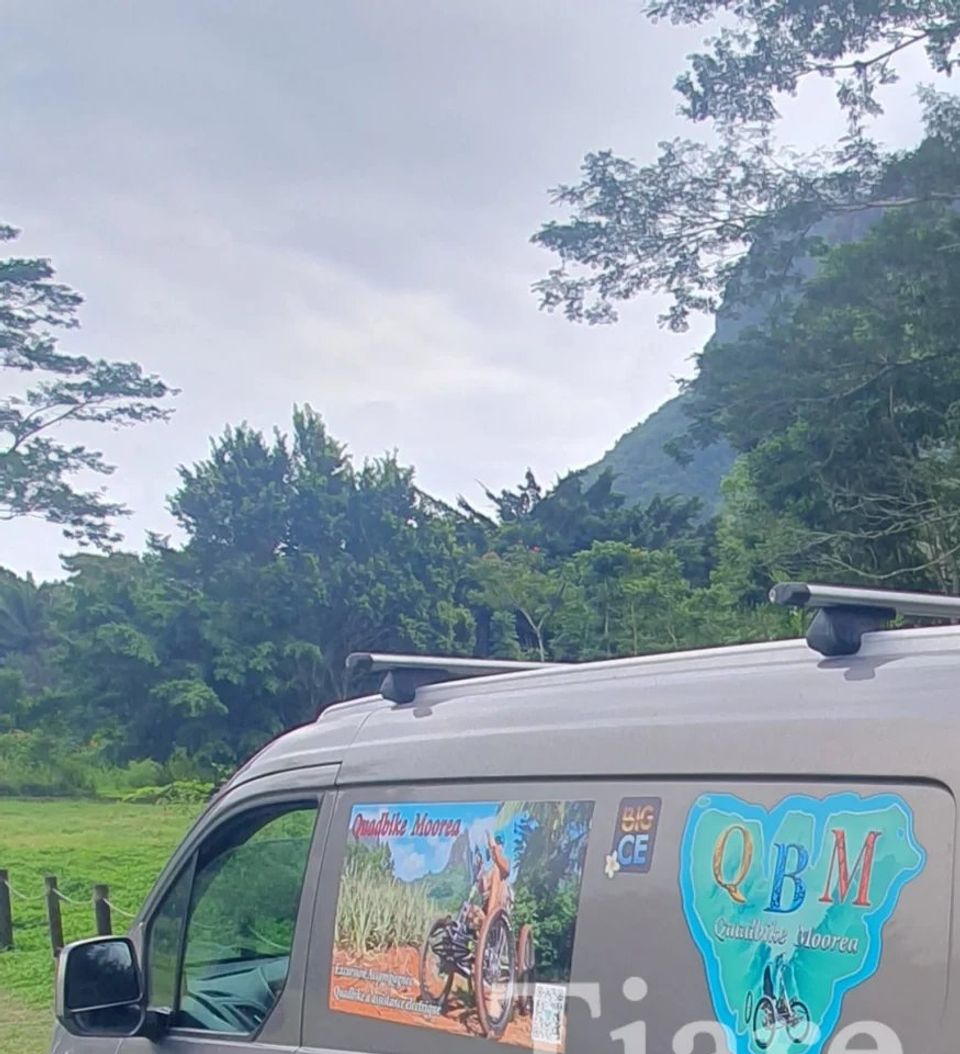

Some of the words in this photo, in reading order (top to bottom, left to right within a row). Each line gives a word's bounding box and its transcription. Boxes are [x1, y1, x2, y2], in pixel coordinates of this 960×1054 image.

[353, 812, 407, 840] Quadbike
[410, 812, 461, 836] Moorea
[618, 833, 649, 865] CE
[713, 825, 883, 913] QBM
[713, 918, 787, 945] Quadbike
[794, 925, 859, 953] Moorea
